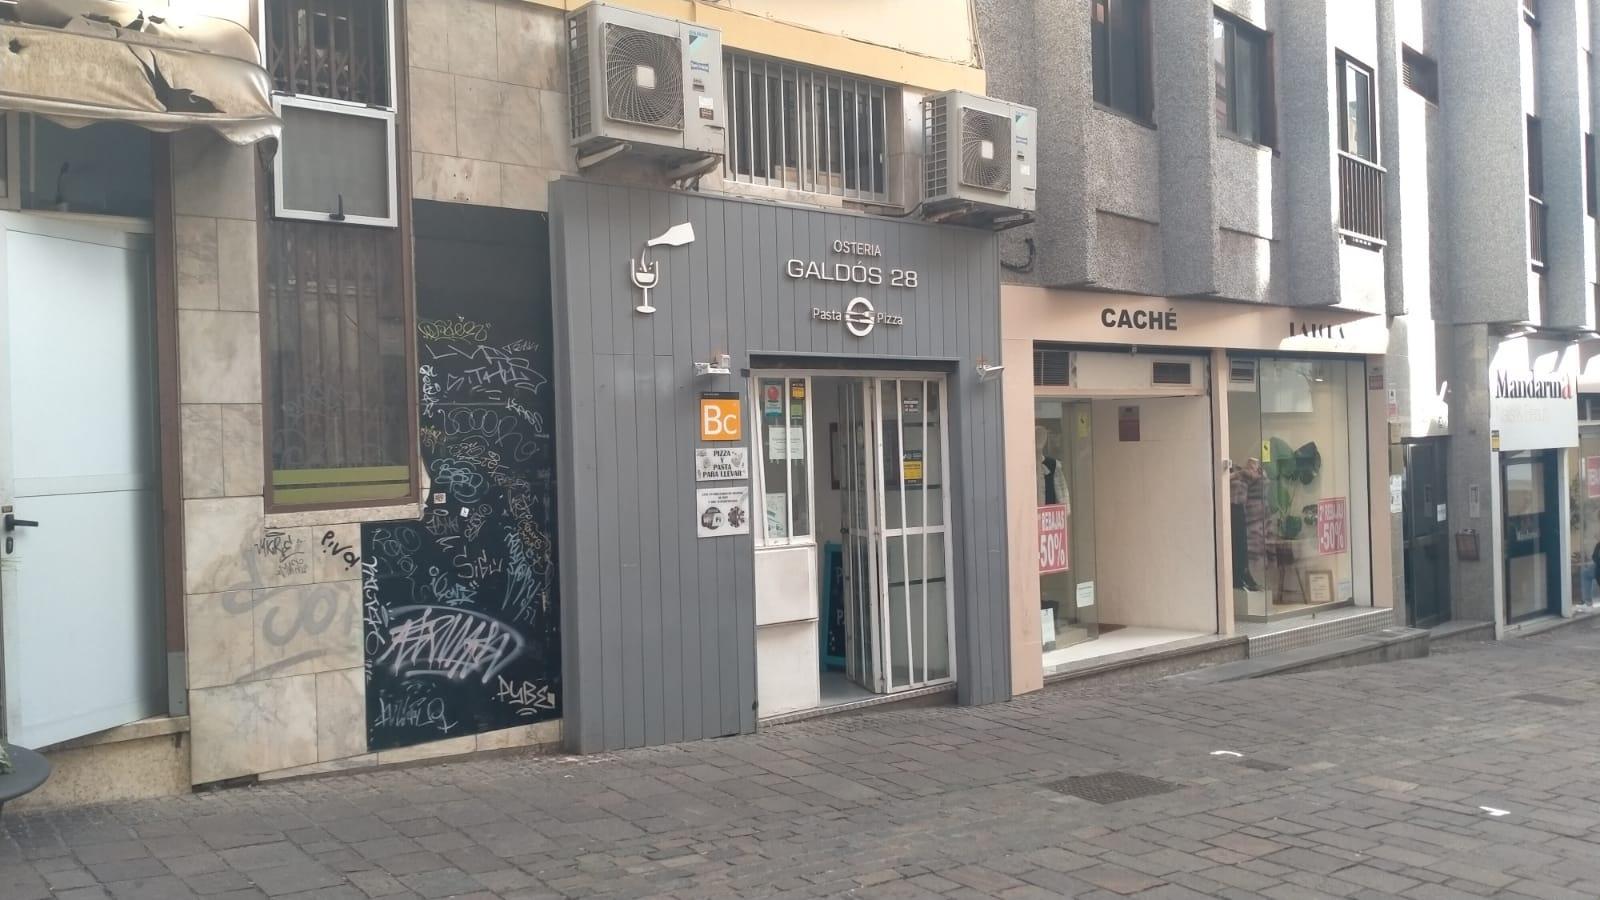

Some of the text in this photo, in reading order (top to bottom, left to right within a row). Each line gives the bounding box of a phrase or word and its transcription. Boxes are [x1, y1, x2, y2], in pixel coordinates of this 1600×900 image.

[833, 239, 881, 256] OSTERIA
[787, 259, 918, 287] GALDÓS 28
[813, 307, 903, 325] Pasta Pizza
[1101, 308, 1177, 330] CACHÉ
[703, 405, 737, 435] Bc
